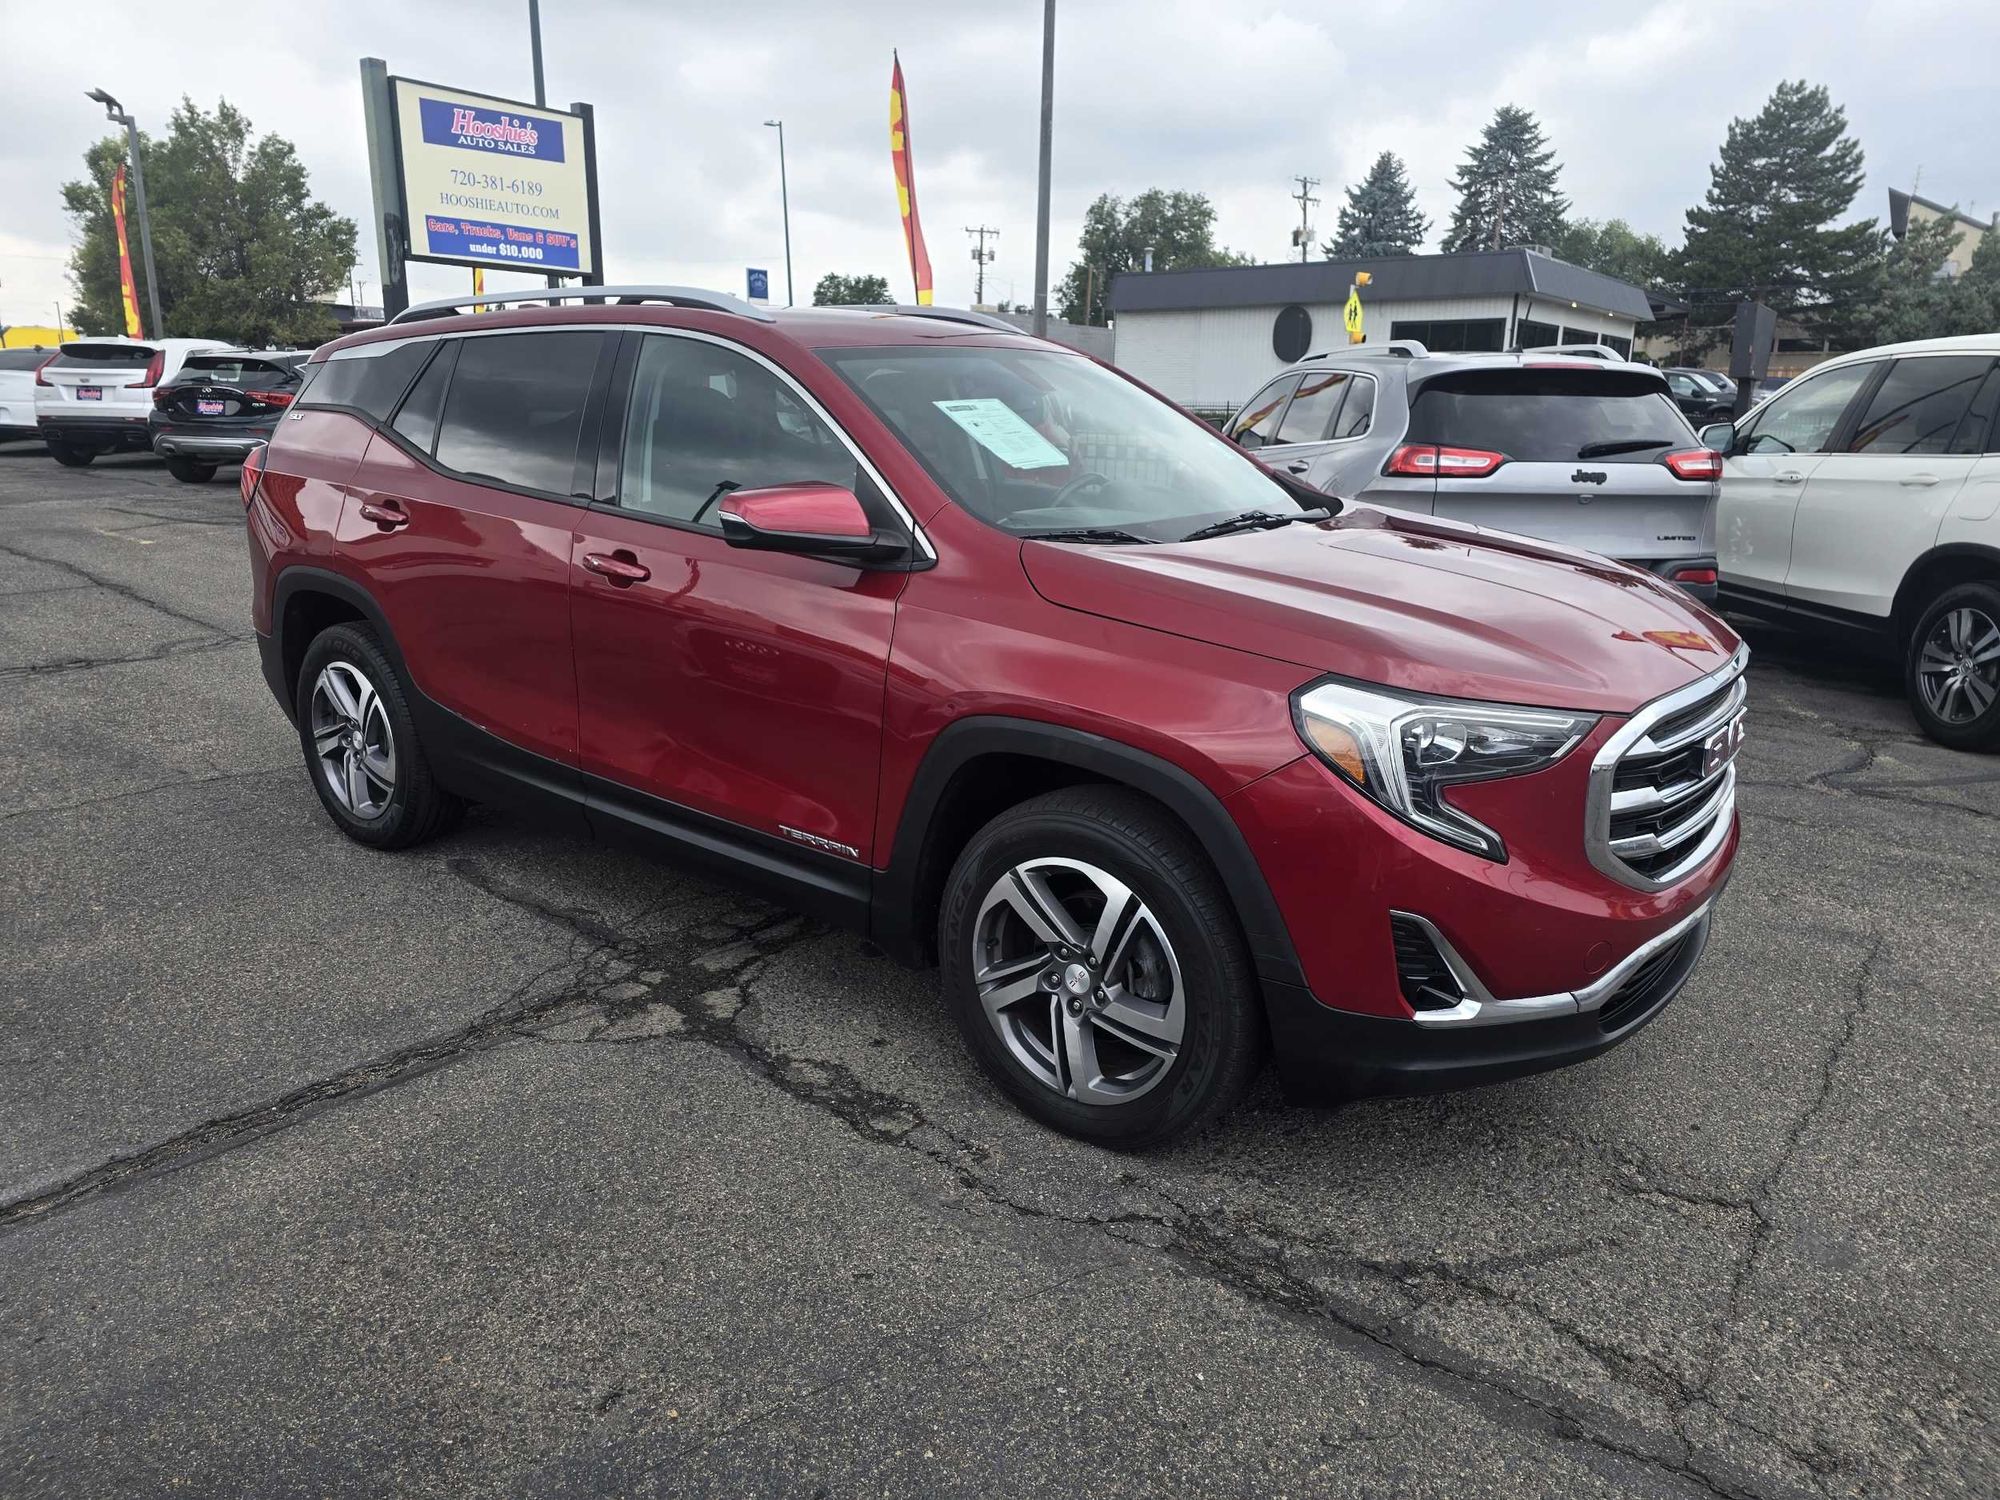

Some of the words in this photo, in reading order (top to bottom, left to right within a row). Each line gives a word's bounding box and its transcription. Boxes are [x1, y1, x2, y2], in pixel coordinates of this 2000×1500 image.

[451, 108, 538, 145] Hooshie's
[458, 136, 495, 148] AUTO
[498, 141, 536, 155] SALES
[450, 169, 543, 197] 720-381-6189
[440, 192, 560, 219] HOOSHIEAUTO.COM
[428, 218, 459, 235] Cars,
[469, 243, 497, 255] under
[499, 243, 543, 260] $10,000
[1571, 469, 1607, 485] Jeep
[778, 824, 859, 858] TERRAIN
